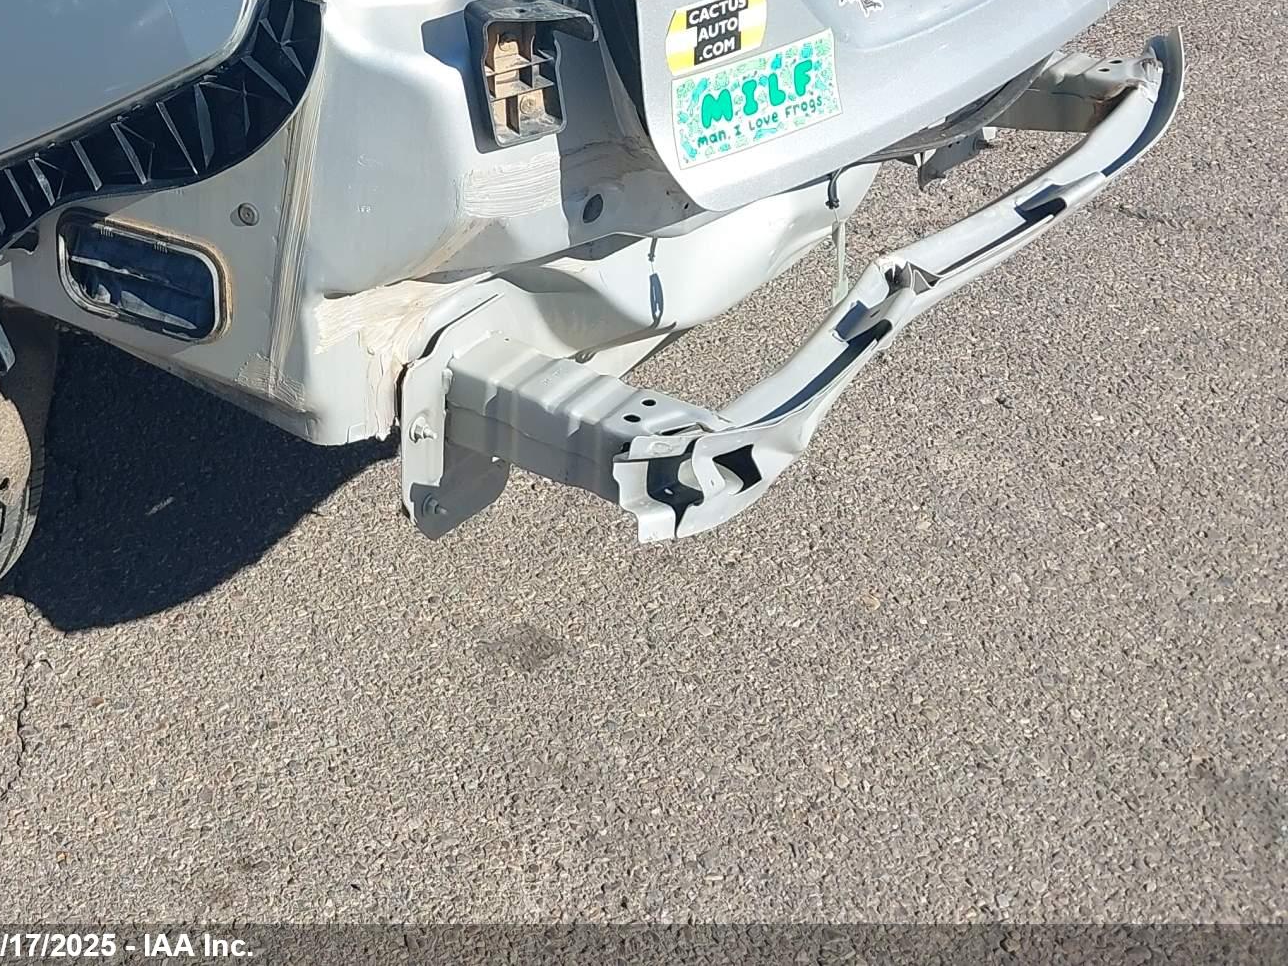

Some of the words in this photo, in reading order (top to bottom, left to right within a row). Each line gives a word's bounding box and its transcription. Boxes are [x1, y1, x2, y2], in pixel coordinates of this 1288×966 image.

[698, 17, 739, 42] AUTO
[698, 38, 736, 61] .COM
[734, 124, 742, 136] I
[748, 112, 778, 131] Love
[785, 95, 823, 118] Frogs
